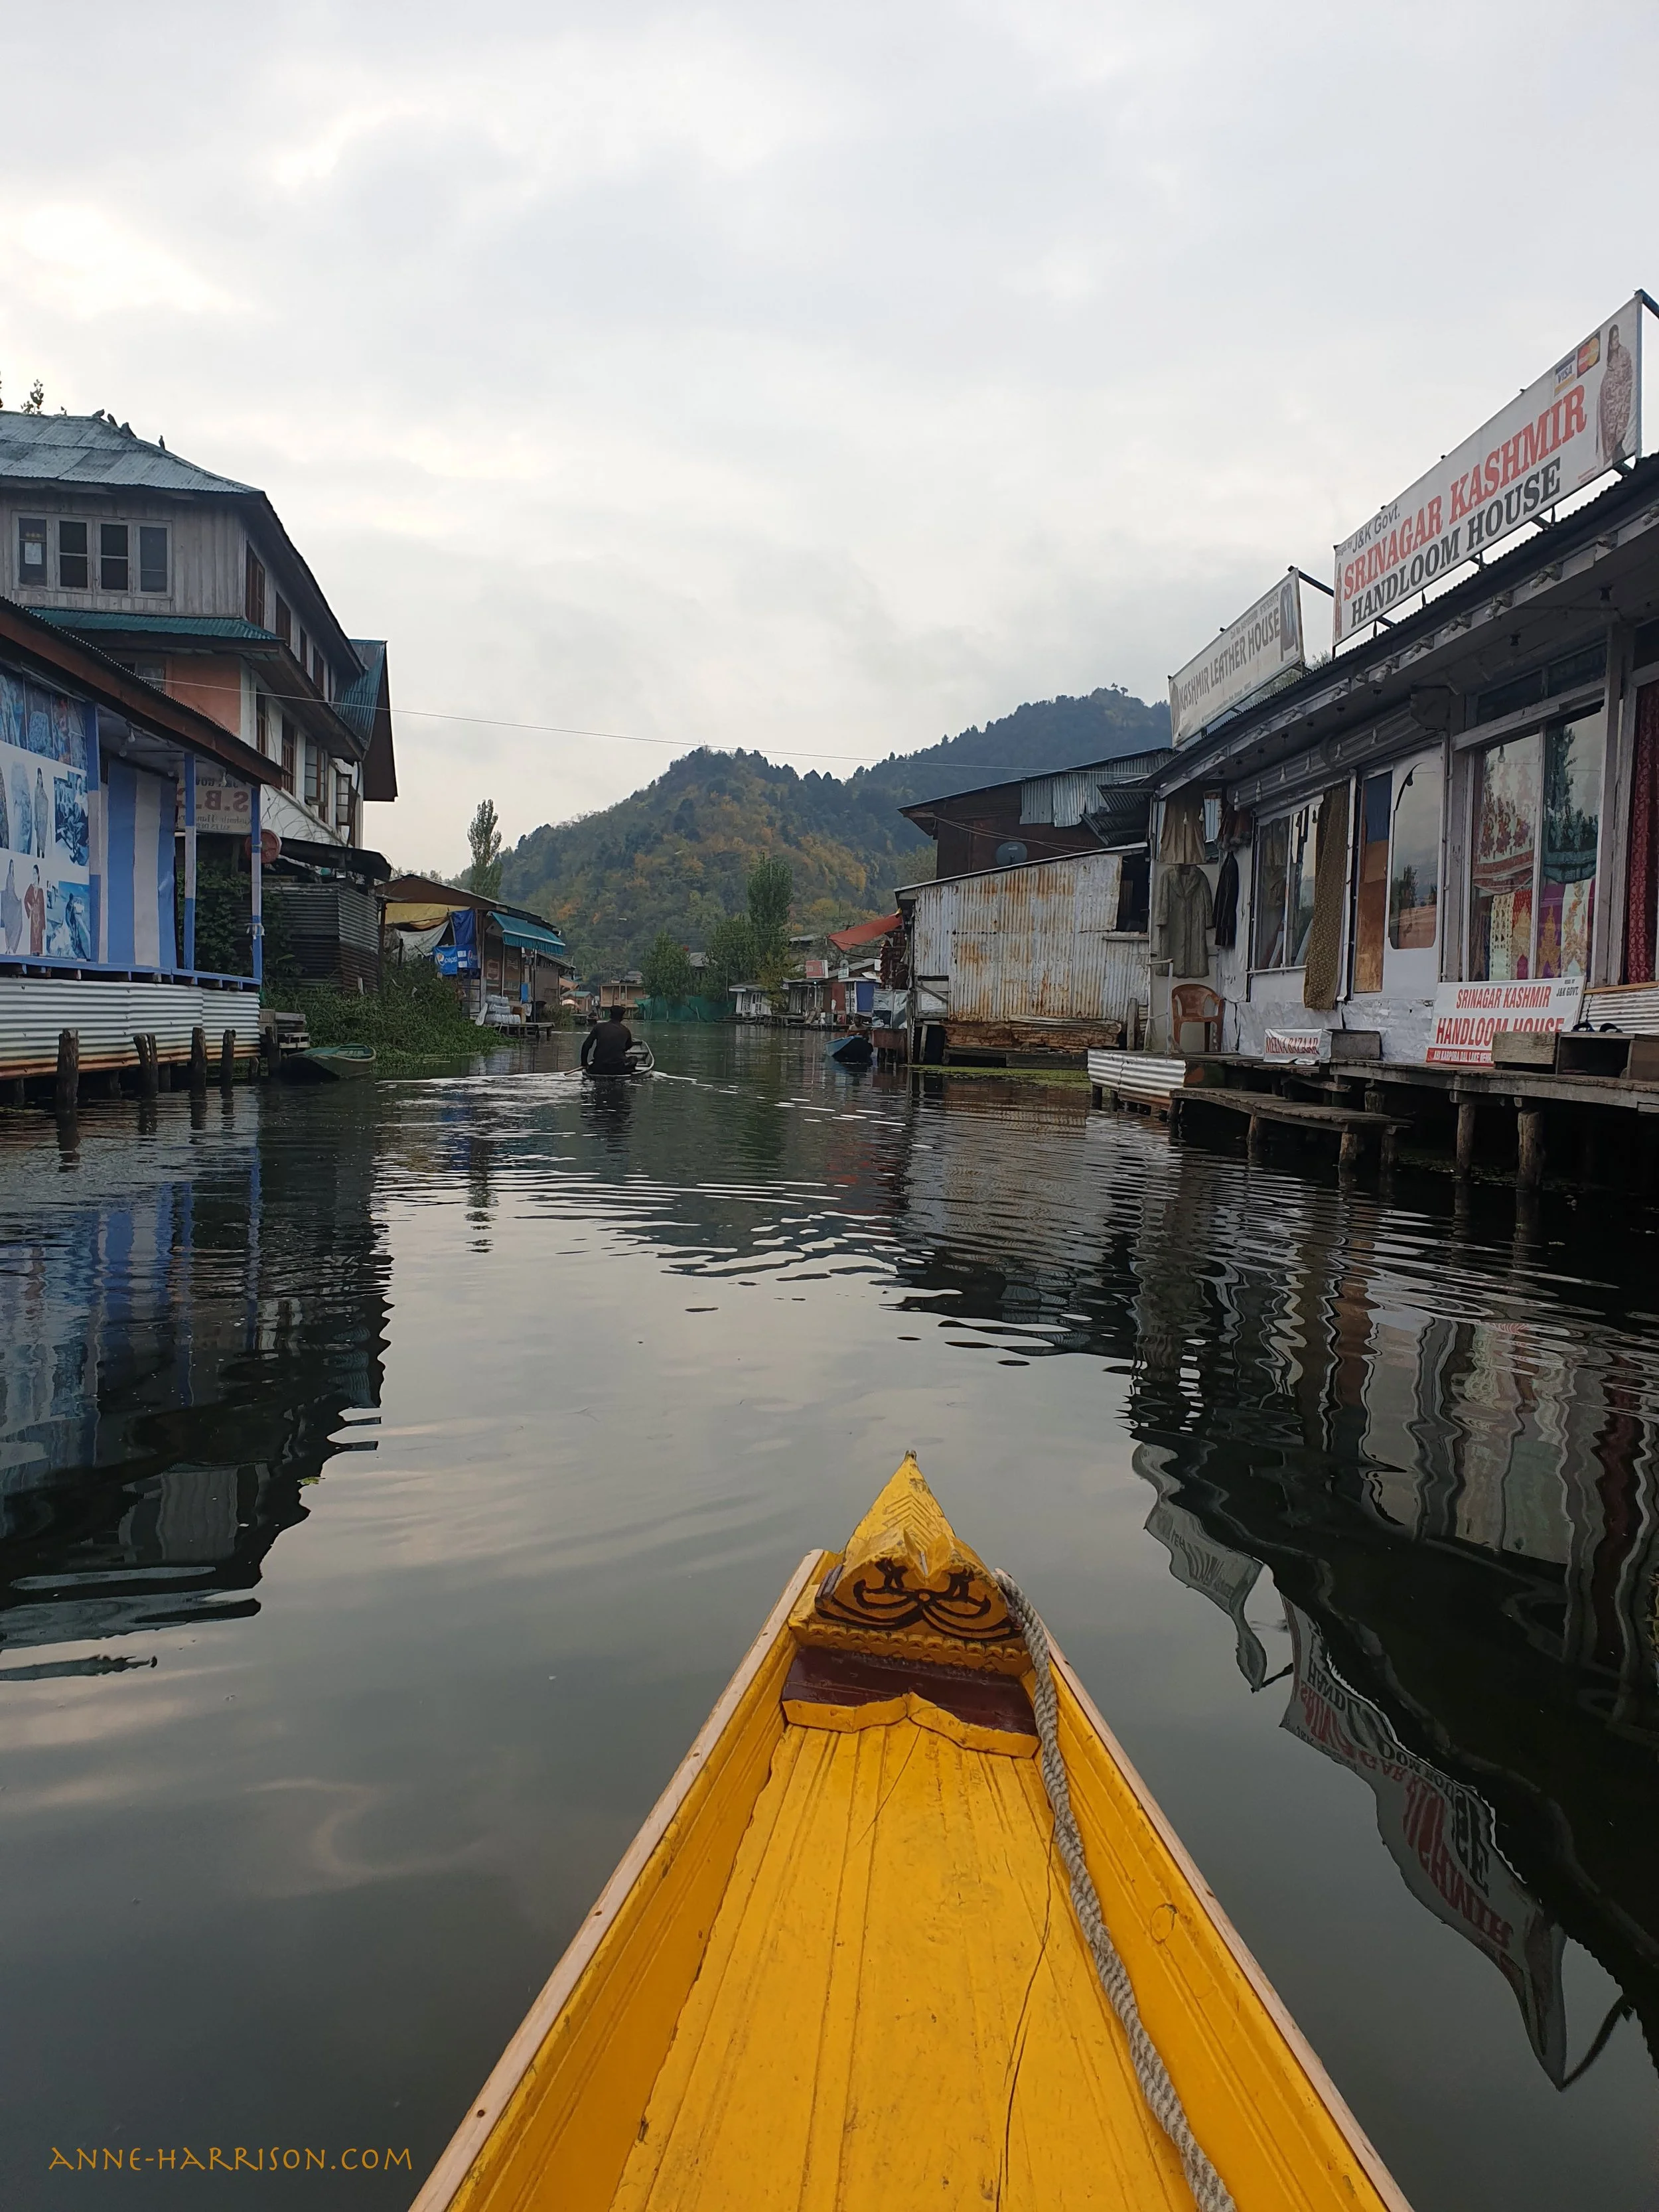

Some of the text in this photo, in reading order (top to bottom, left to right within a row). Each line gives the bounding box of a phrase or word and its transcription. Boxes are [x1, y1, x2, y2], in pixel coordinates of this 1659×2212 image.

[1557, 364, 1573, 384] VISA
[1344, 384, 1588, 601] SRINAGAR KASHMIR
[1352, 522, 1371, 553] J&K
[1374, 503, 1400, 535] Govt.
[1350, 534, 1459, 629] HANDLOOM
[1466, 456, 1561, 552] HOUSE
[1178, 664, 1210, 712] KASHMIR
[1210, 636, 1248, 688] LEATHER
[1248, 607, 1281, 661] HOUSE
[1456, 986, 1551, 1009] SRINAGAR KASHMIR
